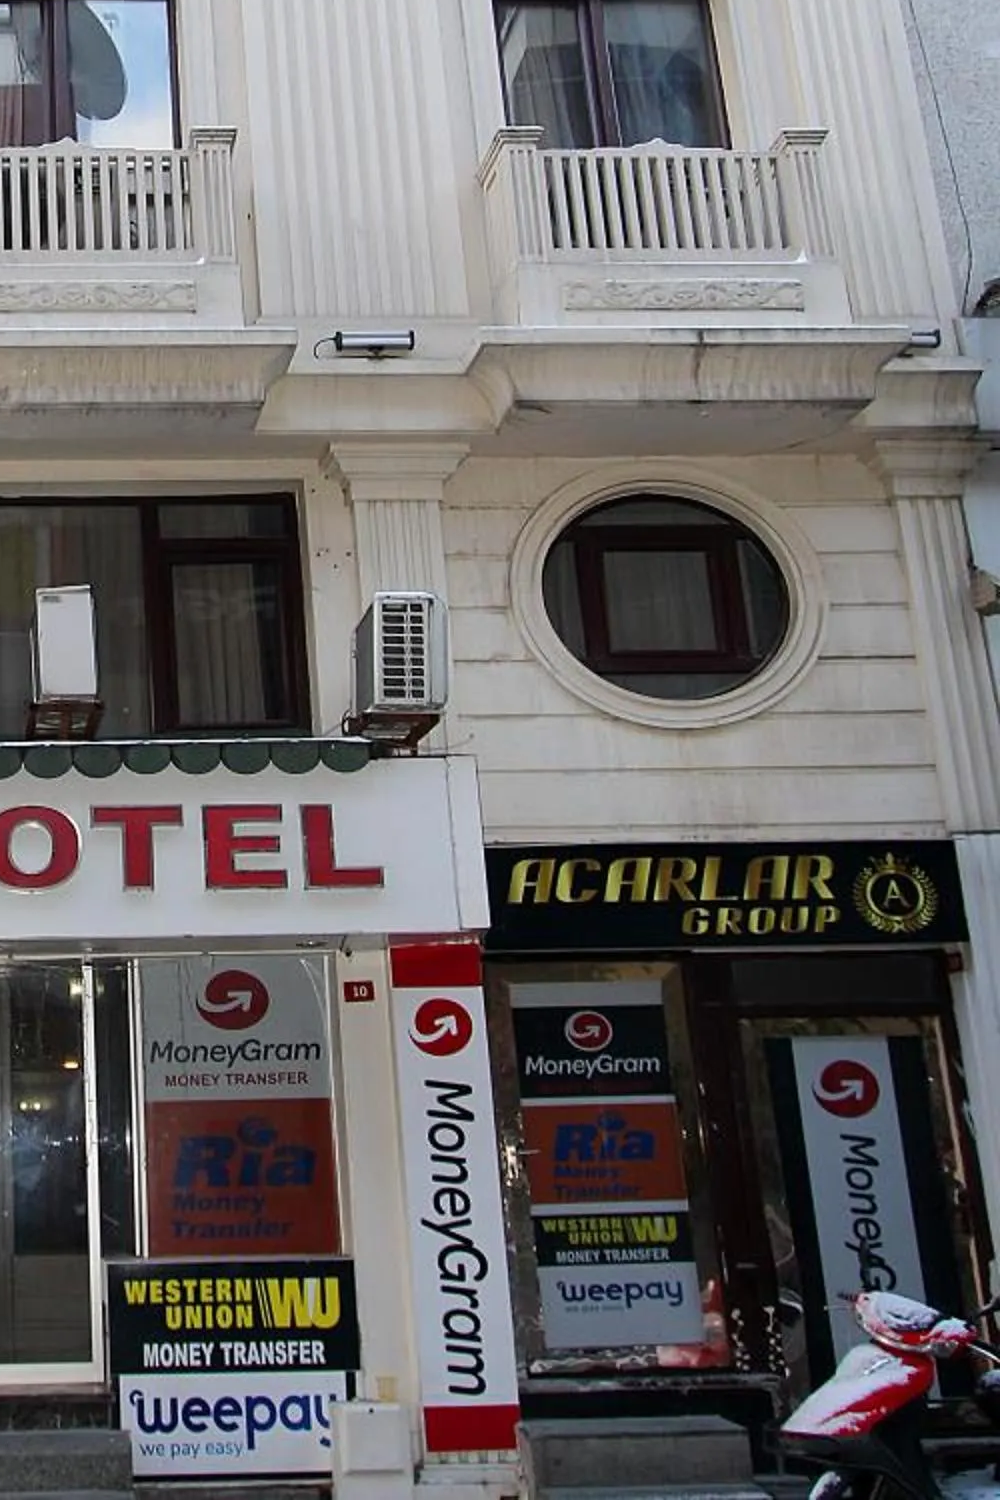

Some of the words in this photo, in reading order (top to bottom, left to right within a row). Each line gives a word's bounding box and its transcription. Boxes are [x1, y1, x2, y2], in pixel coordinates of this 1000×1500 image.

[507, 854, 836, 904] ACARLAR
[882, 879, 908, 909] A
[681, 905, 841, 935] GROUP
[353, 986, 368, 997] 10
[150, 1039, 321, 1068] MoneyGram
[525, 1054, 661, 1079] MoneyGram
[165, 1074, 220, 1087] MONEY
[226, 1071, 309, 1086] TRANSFER
[555, 1111, 656, 1162] Ria
[174, 1116, 317, 1187] Ria
[420, 1078, 489, 1396] MoneyGram
[541, 1217, 624, 1233] WESTERN
[567, 1230, 625, 1245] UNION
[630, 1215, 678, 1243] WU
[556, 1249, 600, 1264] MONEY
[603, 1247, 670, 1262] TRANSFER
[124, 1278, 253, 1304] WESTERN
[267, 1276, 341, 1328] WU
[556, 1280, 684, 1308] weepay
[165, 1304, 253, 1330] UNION
[143, 1342, 215, 1368] MONEY
[220, 1340, 326, 1366] TRANSFER
[140, 1444, 165, 1456] we
[171, 1443, 200, 1459] pay
[205, 1442, 244, 1458] easy
